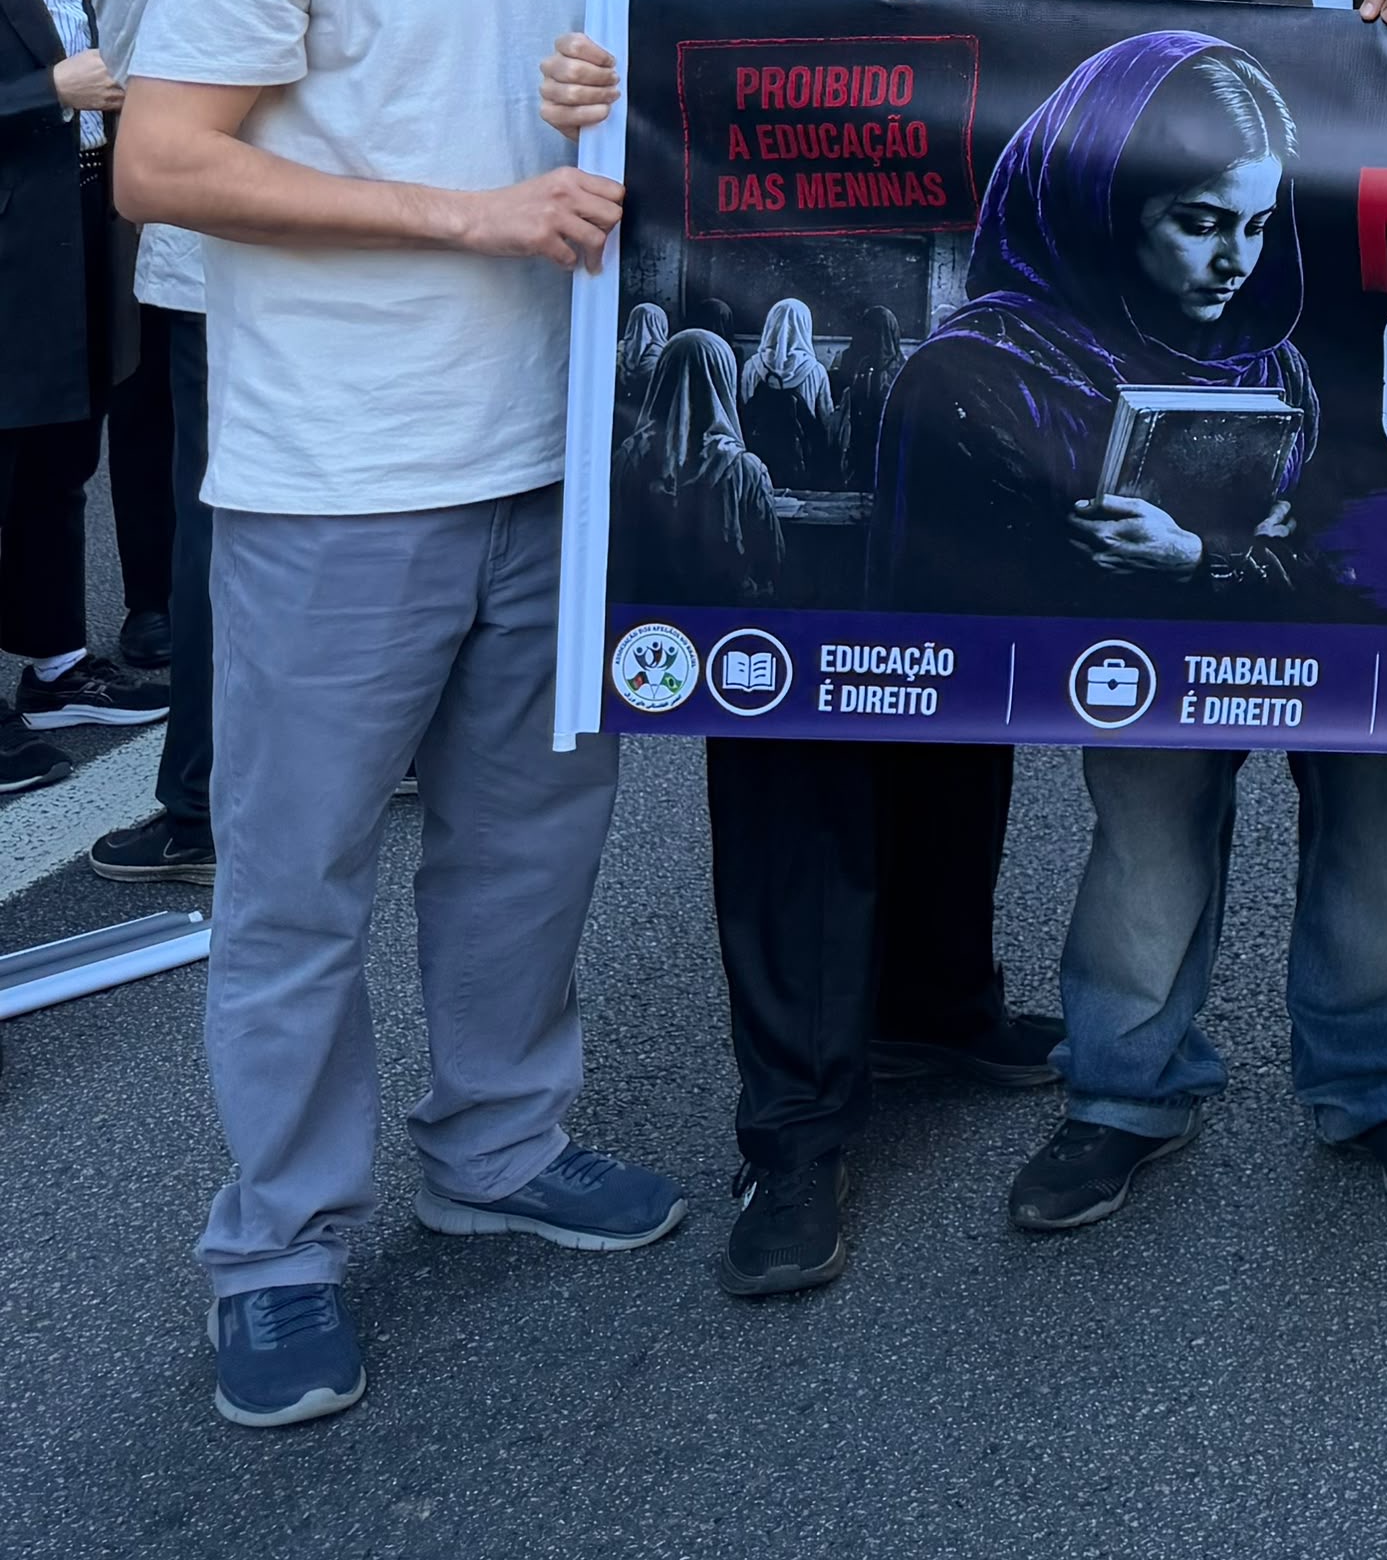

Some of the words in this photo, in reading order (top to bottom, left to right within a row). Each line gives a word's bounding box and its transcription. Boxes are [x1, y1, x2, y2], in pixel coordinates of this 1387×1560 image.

[736, 65, 914, 110] PROIBIDO
[729, 124, 752, 160] A
[756, 114, 928, 167] EDUCAÇÃO
[718, 173, 787, 213] DAS
[796, 171, 947, 209] MENINAS
[820, 643, 955, 682] EDUCAÇÃO
[1184, 655, 1319, 688] TRABALHO
[818, 682, 834, 712] É
[840, 685, 938, 716] DIREITO
[1180, 690, 1197, 724] É
[1203, 696, 1302, 727] DIREITO
